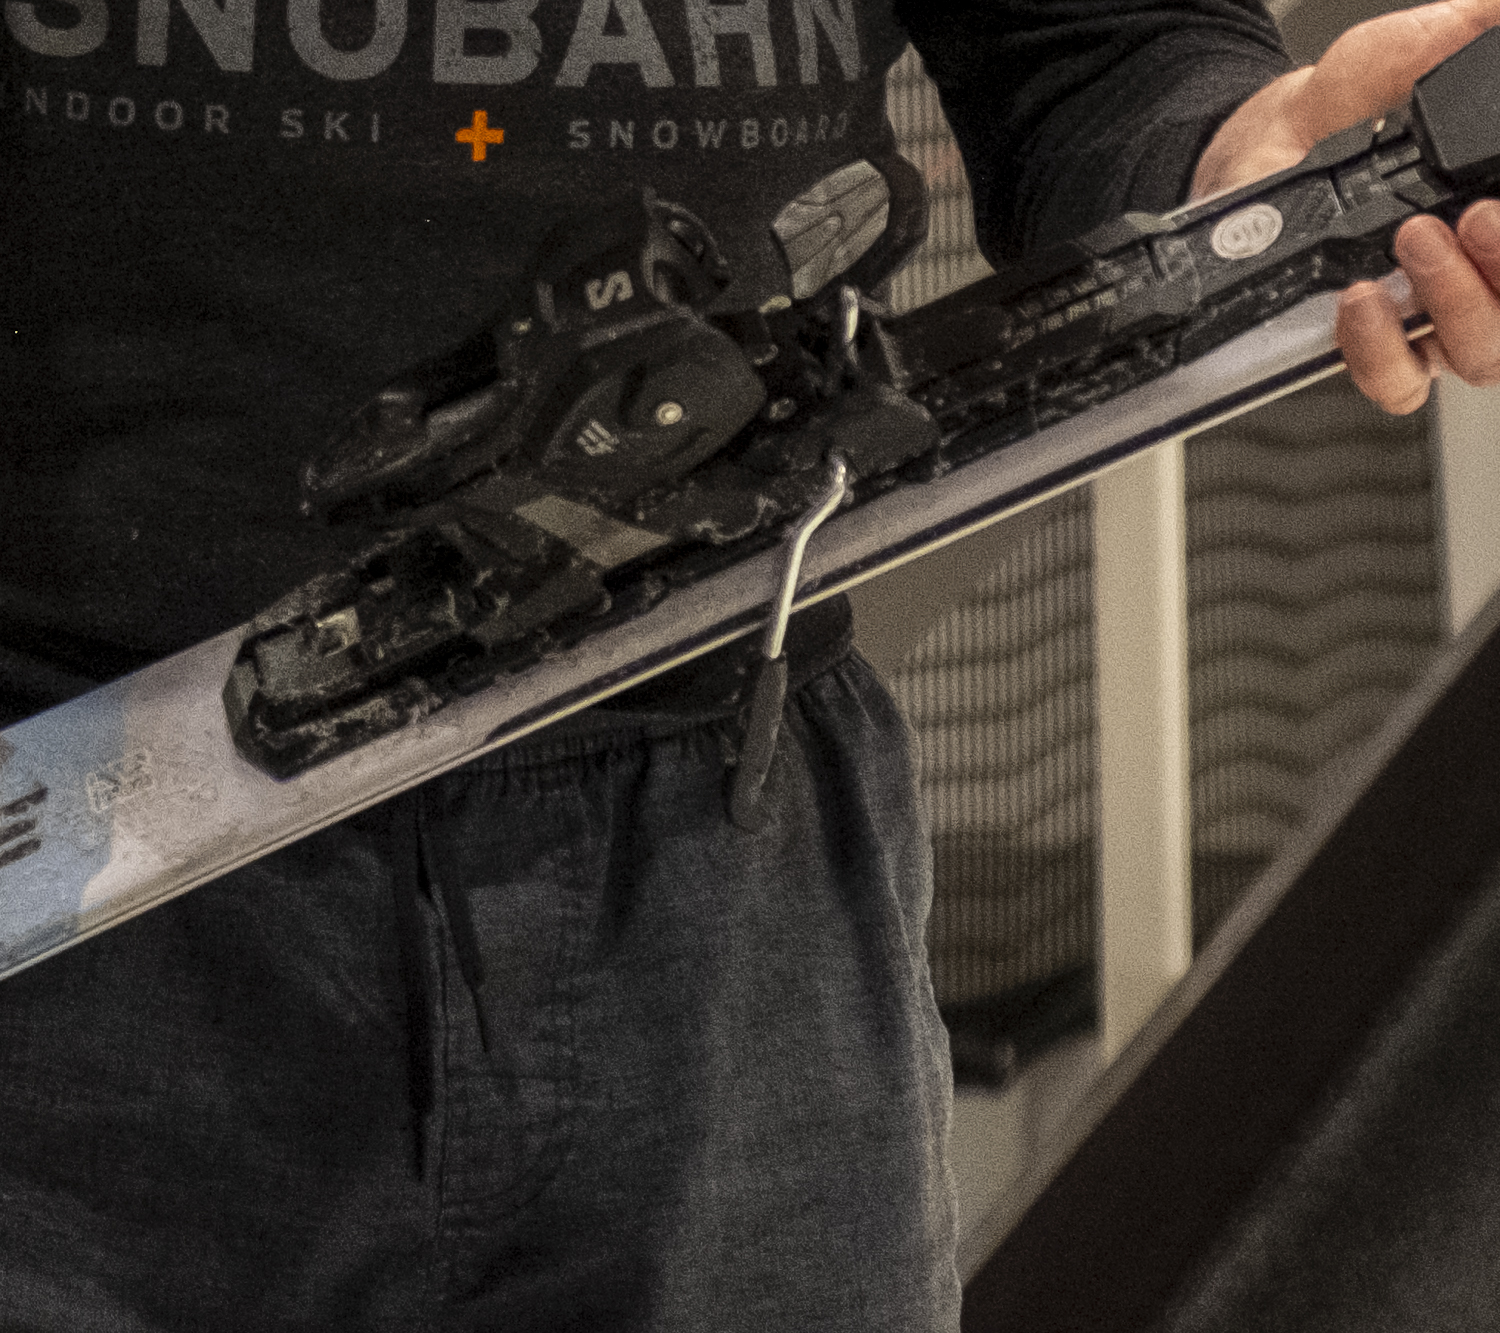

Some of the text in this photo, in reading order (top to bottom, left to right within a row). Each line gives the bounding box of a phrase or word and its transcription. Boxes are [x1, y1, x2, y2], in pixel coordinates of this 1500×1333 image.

[0, 83, 230, 135] NDOOR
[280, 107, 380, 144] SKI
[569, 109, 849, 150] SNOWBOARD
